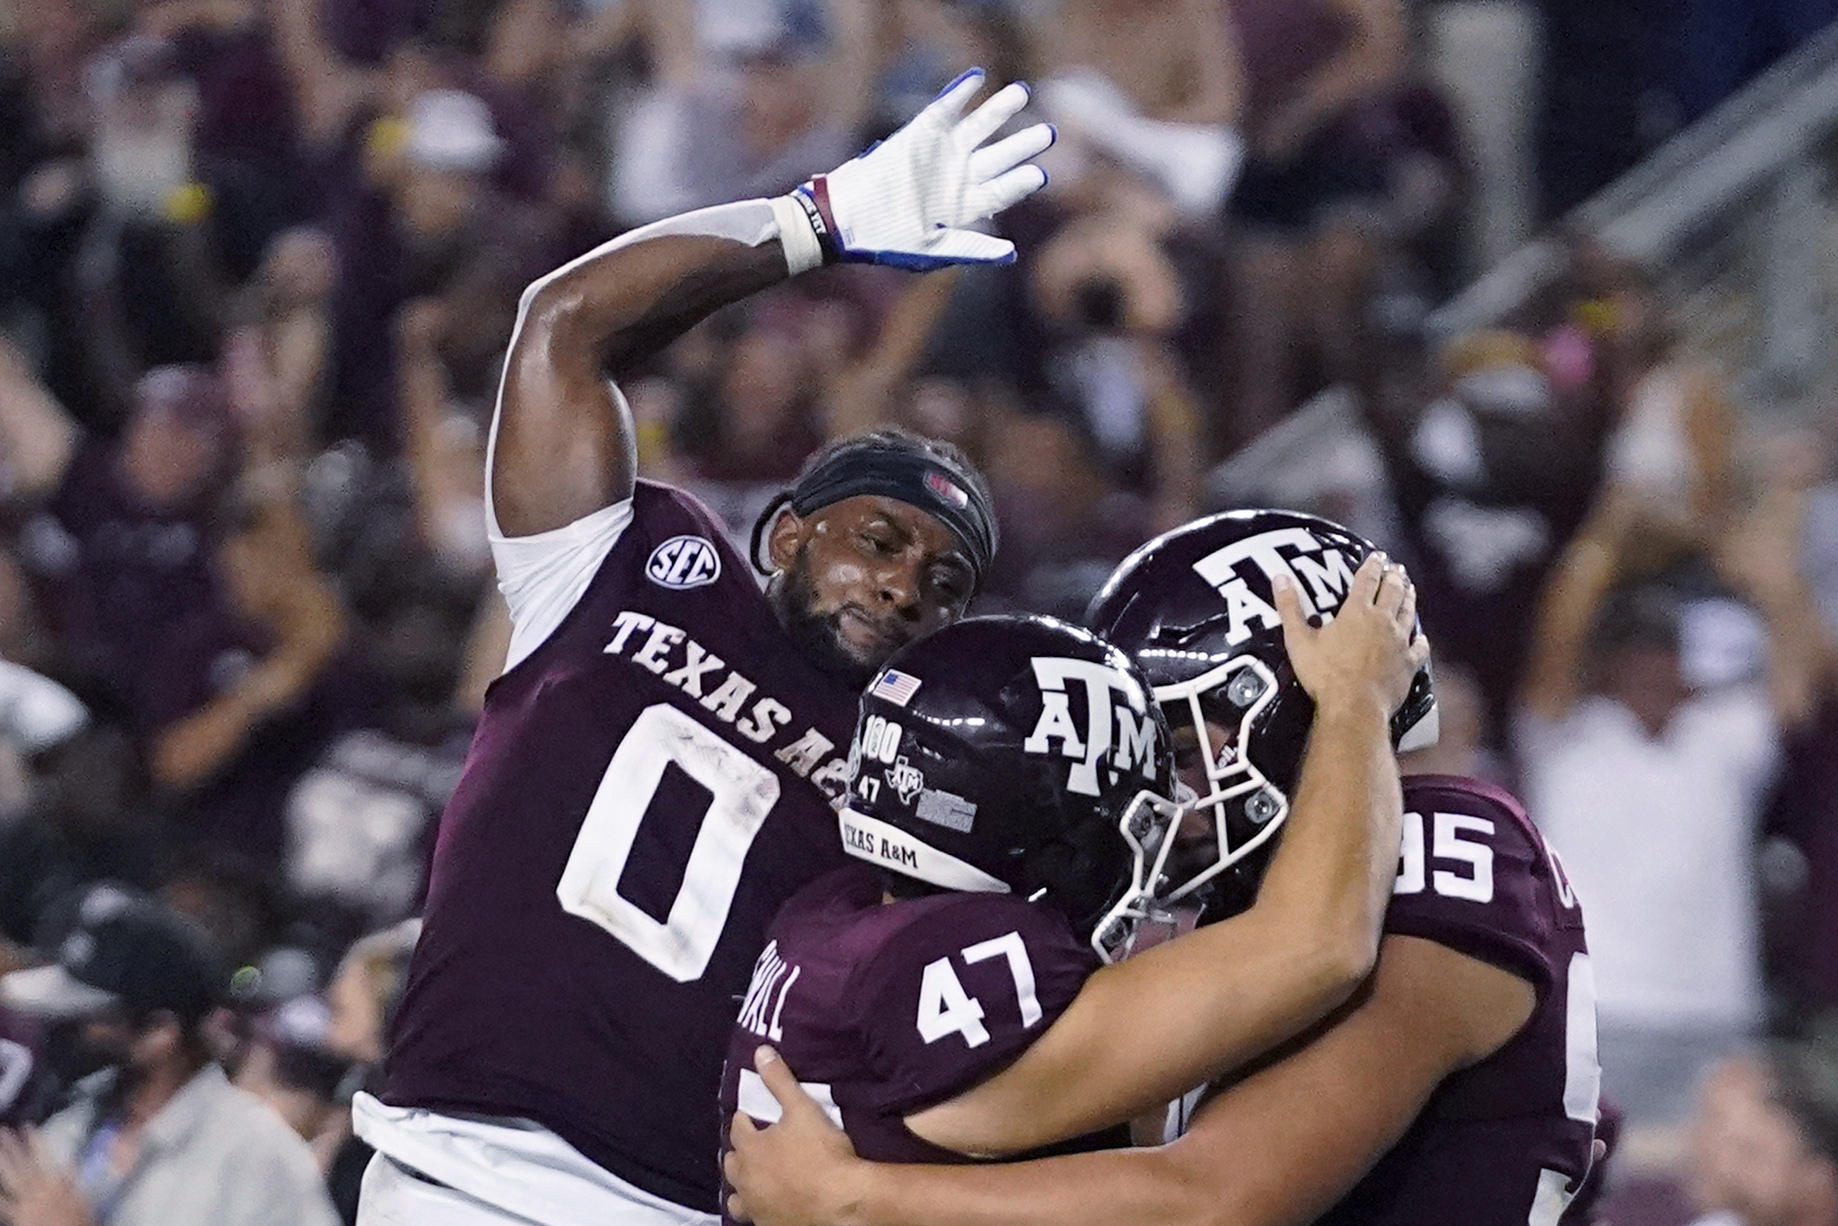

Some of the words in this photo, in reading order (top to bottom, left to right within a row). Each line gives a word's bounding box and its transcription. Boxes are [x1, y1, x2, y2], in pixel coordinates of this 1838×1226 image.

[650, 539, 716, 585] SEC
[604, 610, 793, 744] TEXAS
[773, 726, 851, 813] A&
[858, 775, 881, 804] 47
[555, 702, 781, 983] 0
[880, 838, 919, 870] A&M
[915, 931, 1043, 1049] 47
